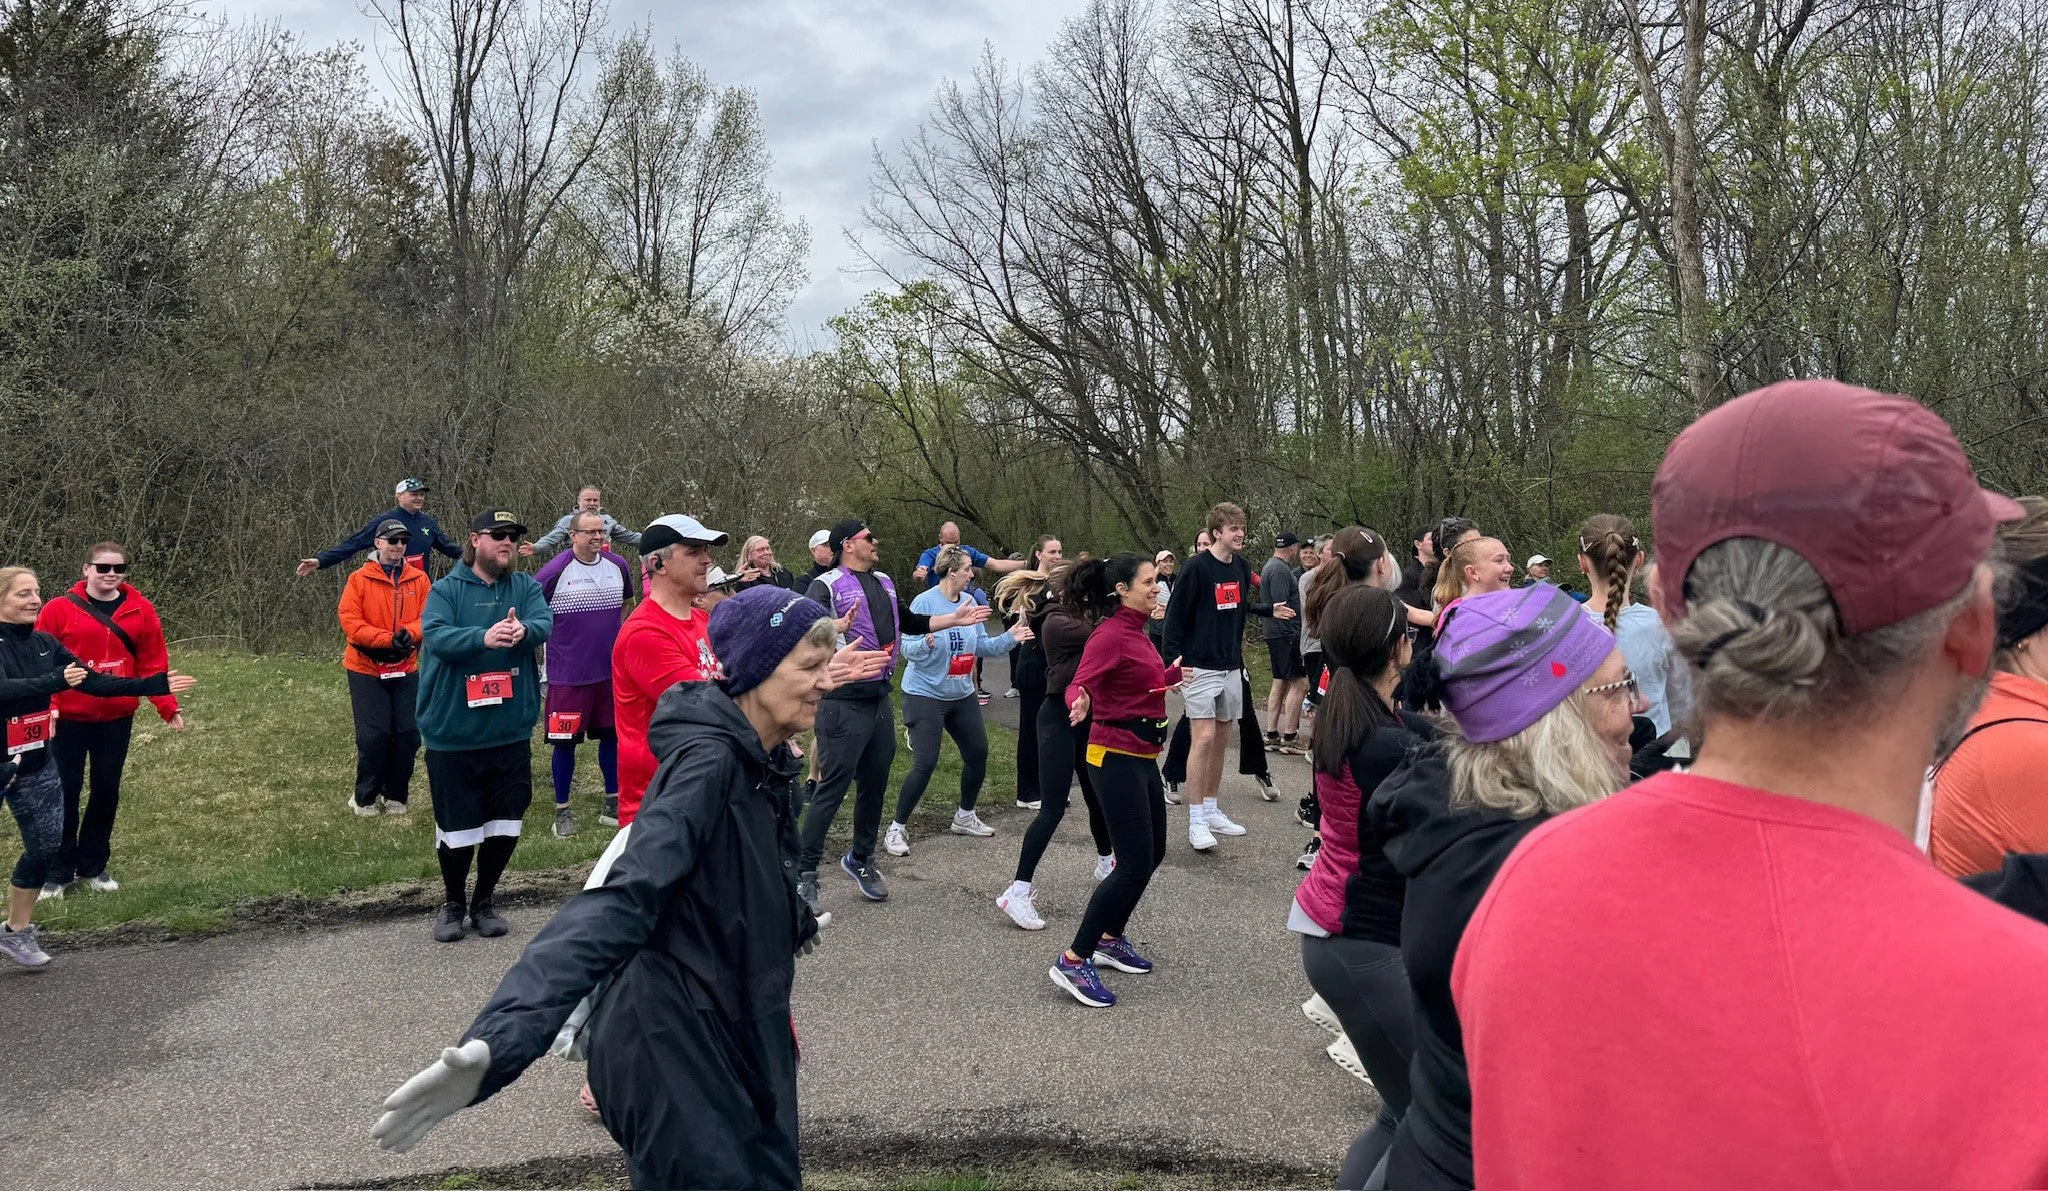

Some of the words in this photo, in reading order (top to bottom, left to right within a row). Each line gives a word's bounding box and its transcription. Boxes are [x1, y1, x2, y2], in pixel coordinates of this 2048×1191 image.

[1224, 591, 1235, 602] 49
[949, 631, 964, 641] BL
[950, 641, 964, 651] UE
[482, 682, 500, 695] 43
[558, 721, 572, 731] 30
[24, 725, 42, 741] 39
